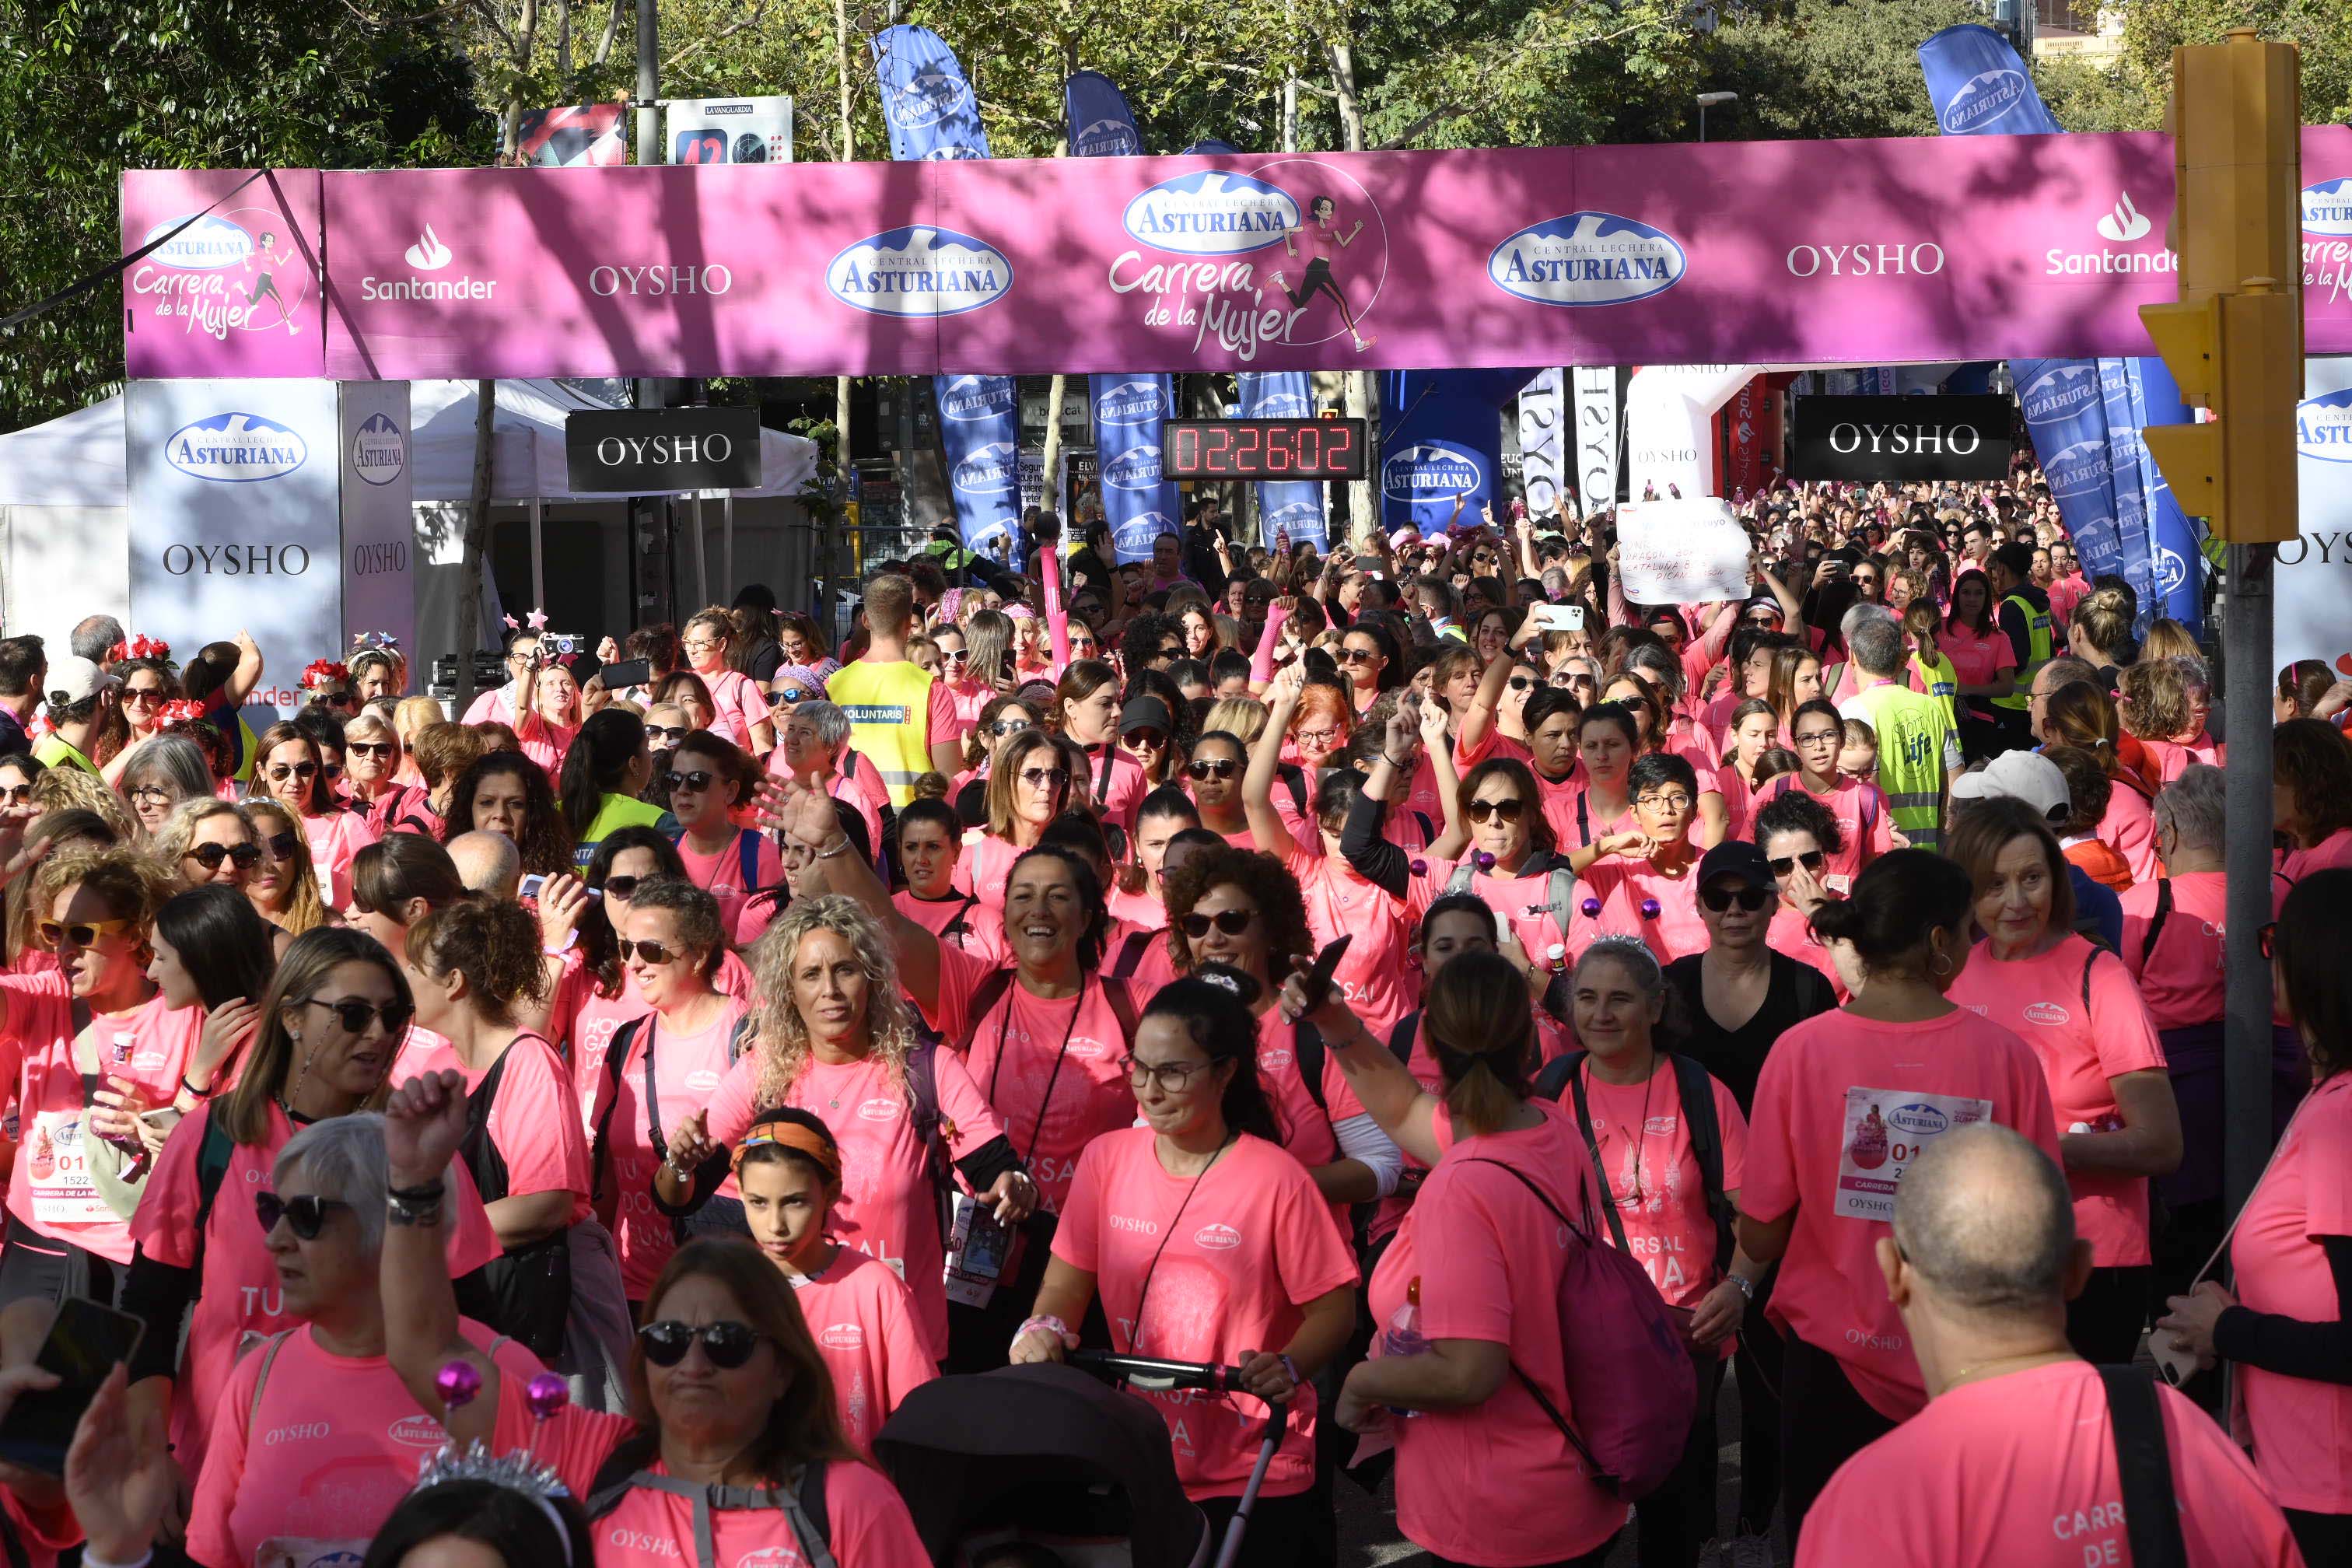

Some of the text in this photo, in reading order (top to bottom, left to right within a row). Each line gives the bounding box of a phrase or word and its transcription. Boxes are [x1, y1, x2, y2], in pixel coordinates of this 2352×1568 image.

[713, 106, 752, 114] VANGUARDIA
[1138, 198, 1286, 234] ASTURIANA
[1224, 198, 1282, 208] LECHERA
[870, 256, 992, 268] CENTRAL LECHERA
[1534, 243, 1665, 255] CENTRAL LECHERA
[1787, 243, 1944, 277] OYSHO
[2046, 248, 2178, 275] Santande
[589, 264, 732, 296] OYSHO
[841, 260, 998, 294] ASTURIANA
[1108, 251, 1252, 293] Carrera
[1505, 249, 1671, 283] ASTURIANA
[2318, 263, 2332, 285] la
[133, 267, 224, 296] Carrera
[362, 275, 497, 300] Santander
[156, 295, 260, 341] de la Mujer
[1144, 287, 1308, 360] de la Mujer
[177, 438, 297, 464] ASTURIANA
[597, 433, 732, 466] OYSHO
[1176, 428, 1350, 471] 02:26:02
[1829, 422, 1980, 455] OYSHO
[356, 439, 402, 467] ASTURIANA
[1637, 448, 1698, 464] OYSHO
[1020, 474, 1033, 484] que
[1385, 472, 1473, 490] ASTURIANA
[163, 544, 310, 576] OYSHO
[354, 541, 407, 576] OYSHO
[242, 686, 302, 707] nder
[1895, 716, 1923, 744] Sport
[1901, 731, 1932, 768] Life
[2025, 1010, 2067, 1022] ASTURIANA
[1892, 1111, 1944, 1129] ASTURIANA
[1854, 1181, 1895, 1192] CARRERA
[1110, 1214, 1157, 1236] OYSHO
[241, 1286, 285, 1317] TU
[1845, 1328, 1902, 1350] OYSHO
[265, 1421, 330, 1446] OYSHO
[2083, 1540, 2121, 1568] DE
